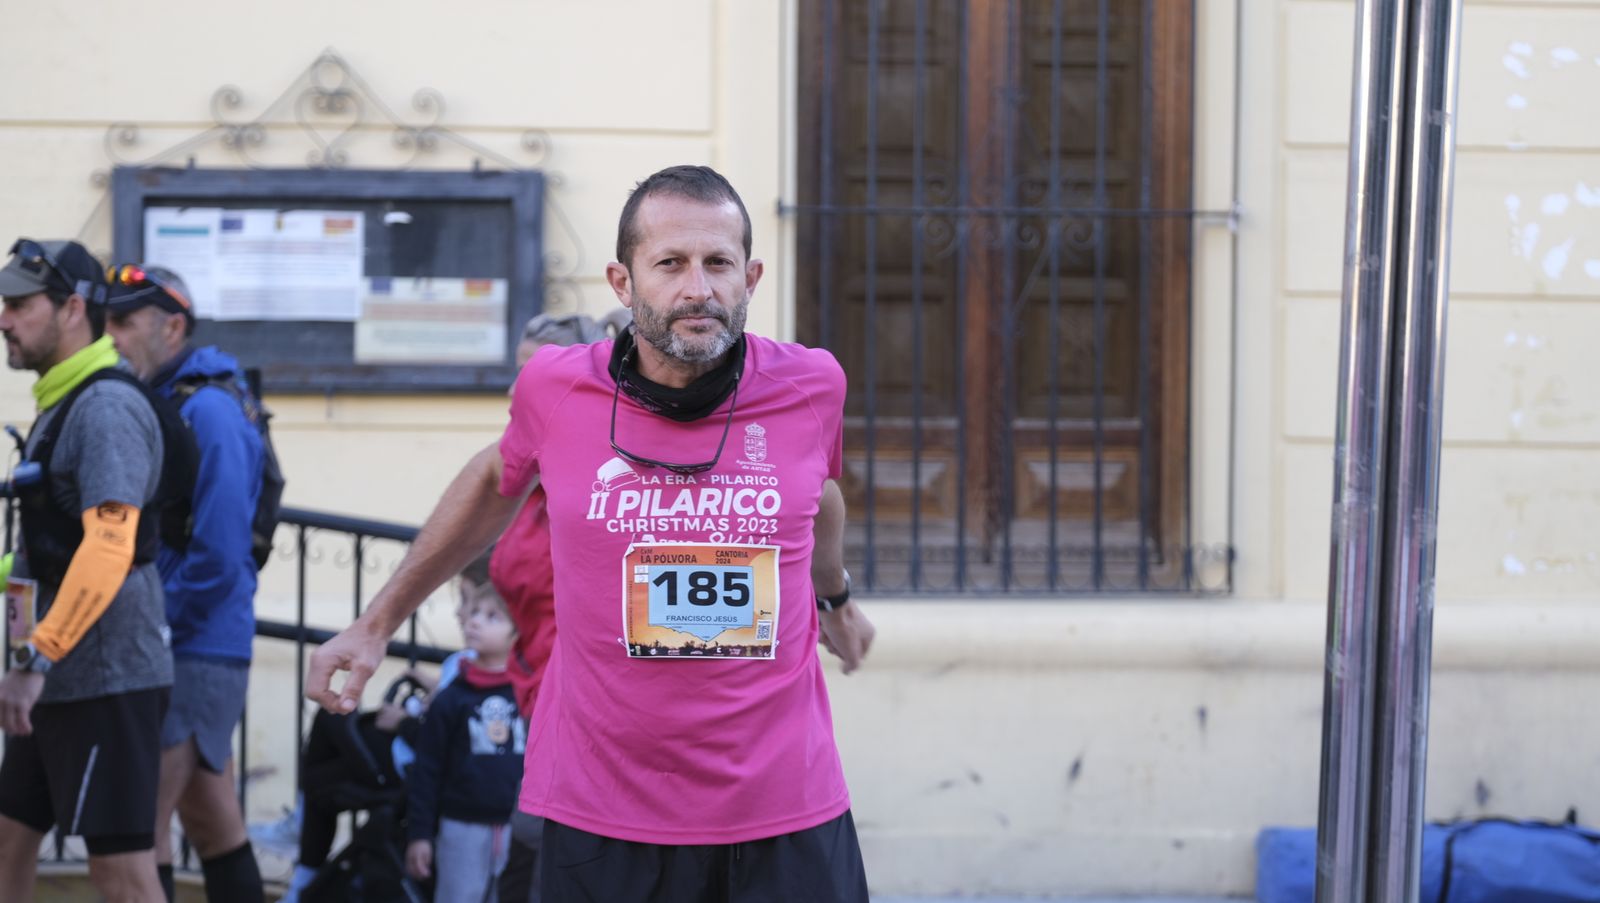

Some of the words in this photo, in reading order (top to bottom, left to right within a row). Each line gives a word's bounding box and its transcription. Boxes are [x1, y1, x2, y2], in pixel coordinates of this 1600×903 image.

[642, 475, 661, 485] LA
[665, 475, 696, 485] ERA
[711, 475, 779, 486] PILARICO
[616, 487, 781, 519] PILARICO
[606, 517, 730, 533] CHRISTMAS
[737, 519, 778, 534] 2023
[640, 555, 652, 564] LA
[654, 552, 697, 564] PÓLVORA
[715, 550, 748, 558] CANTORIA
[652, 571, 750, 607] 185
[666, 615, 712, 623] FRANCISCO
